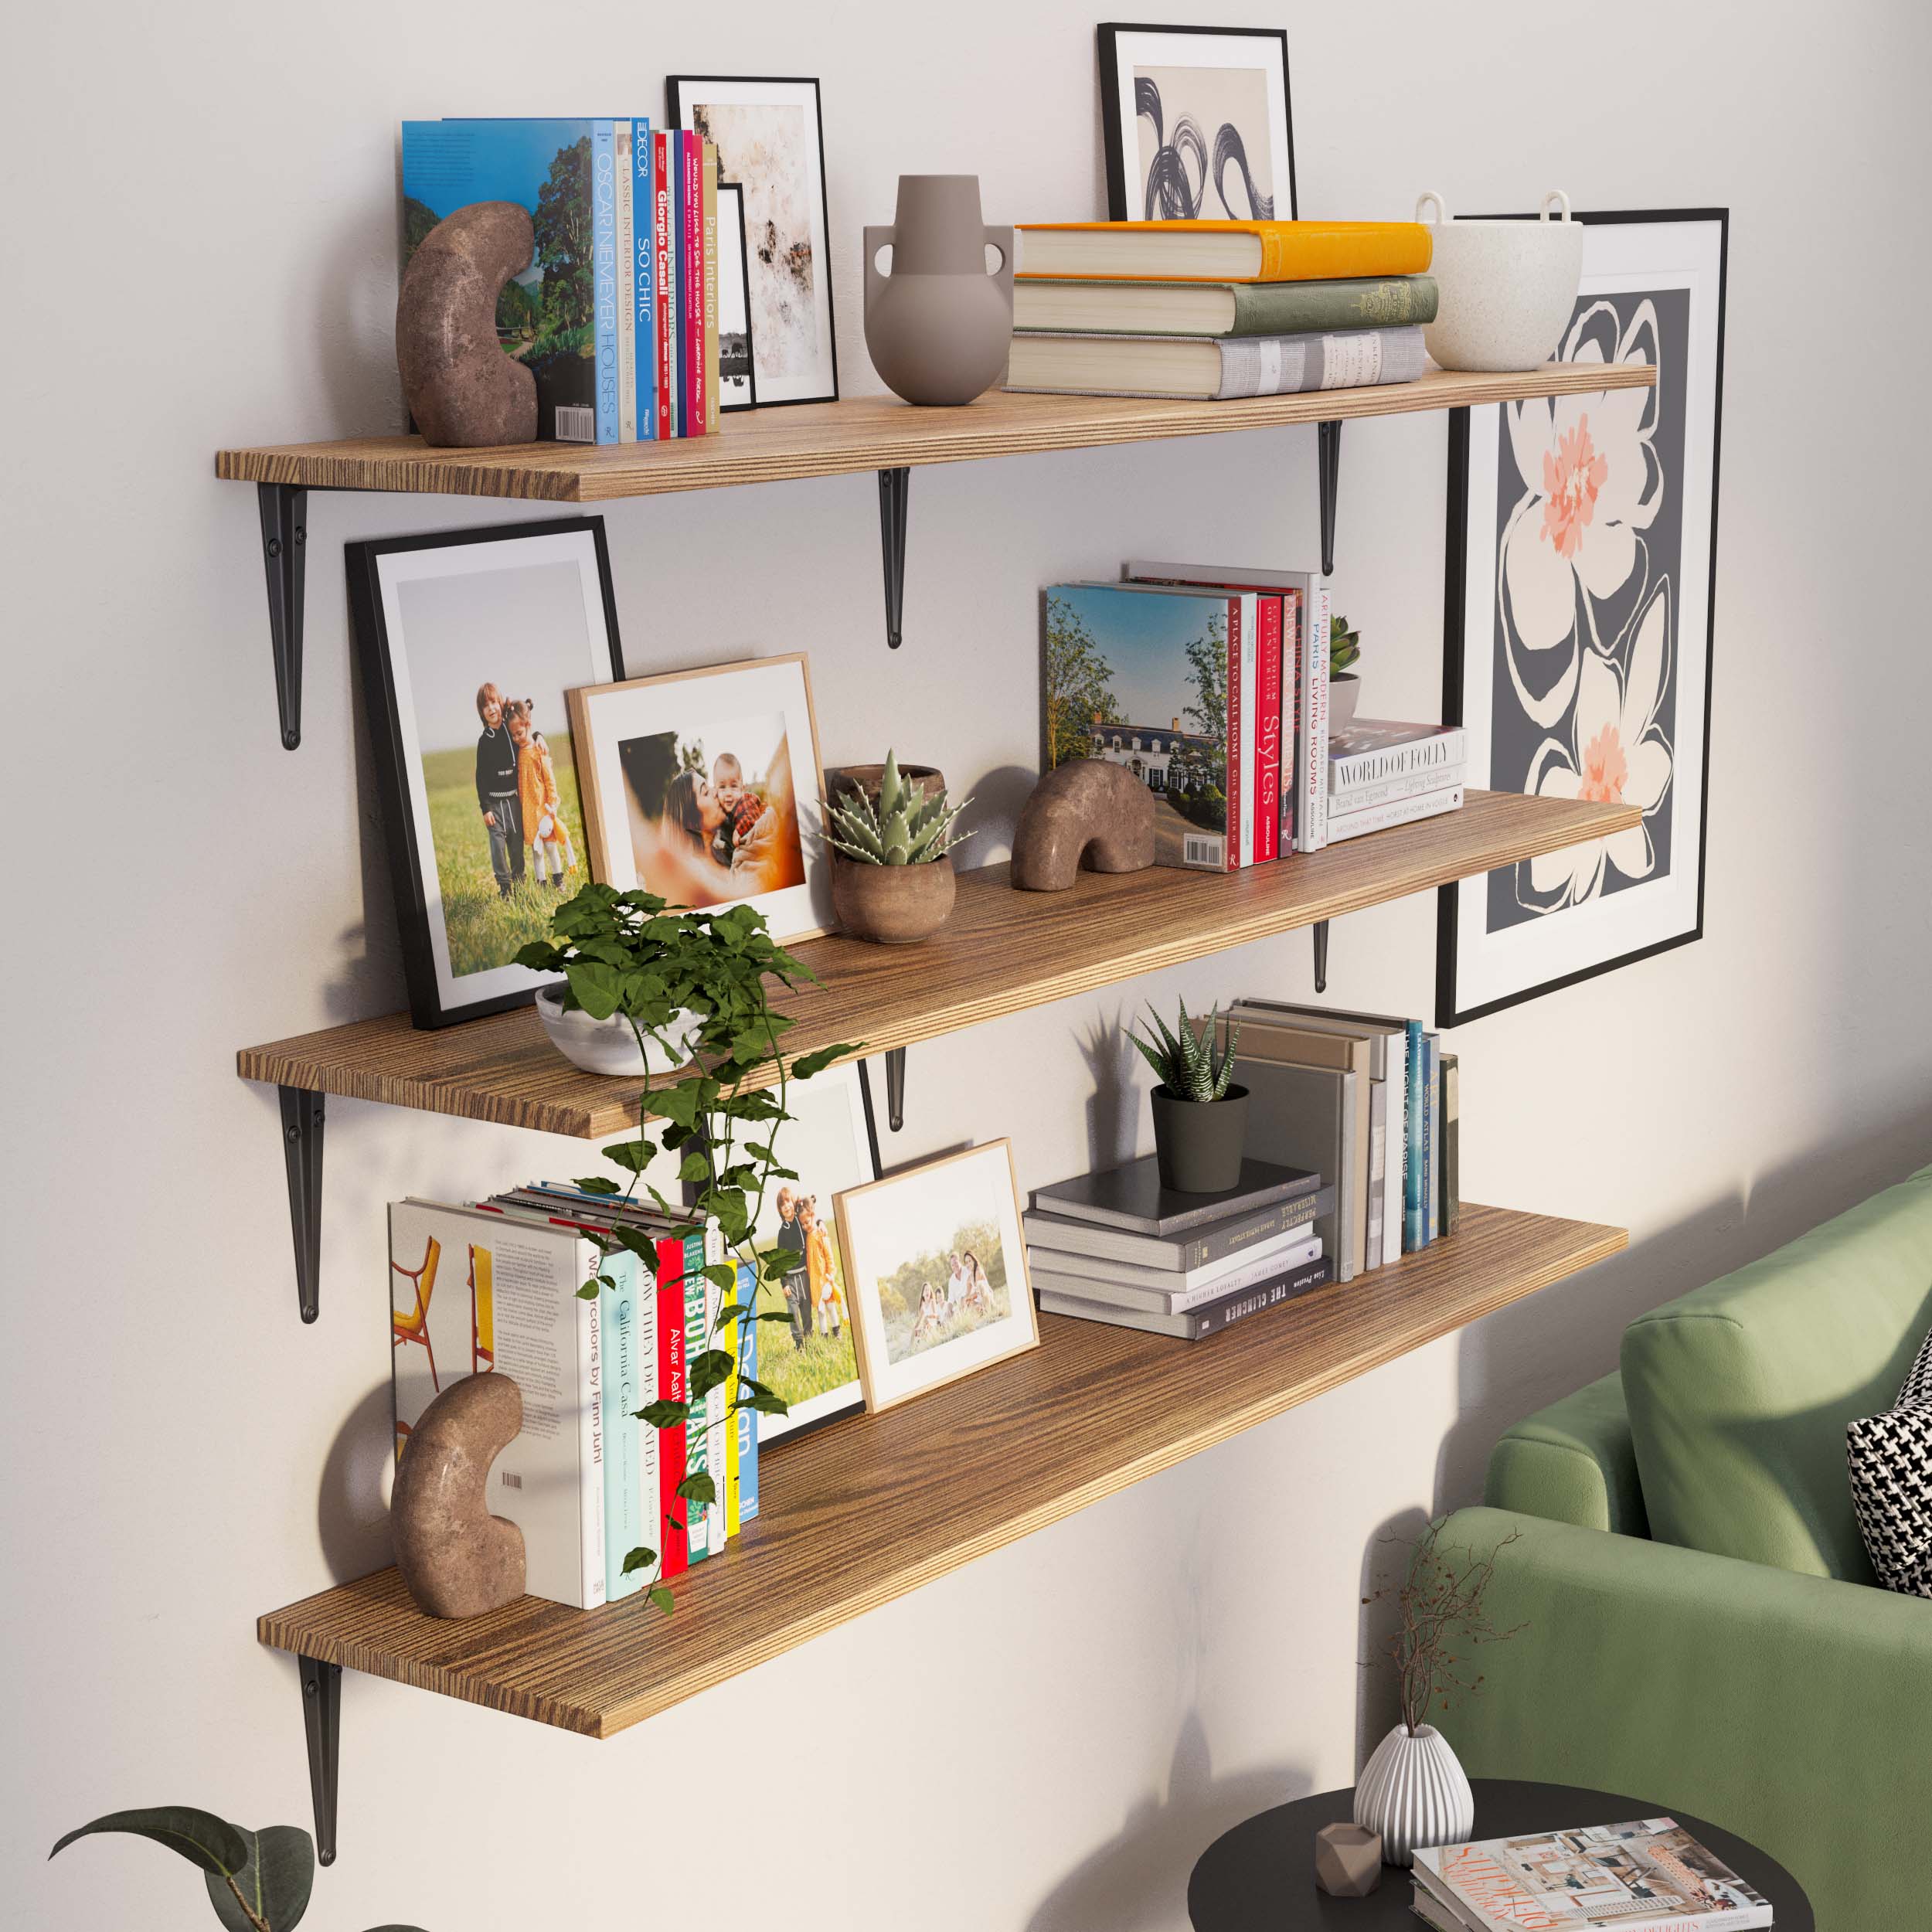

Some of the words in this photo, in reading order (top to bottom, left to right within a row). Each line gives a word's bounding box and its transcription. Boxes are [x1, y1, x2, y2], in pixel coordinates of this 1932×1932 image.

[638, 129, 648, 179] DECOR
[597, 153, 614, 226] OSCAR
[656, 190, 668, 247] Giorgio
[706, 216, 716, 255] Paris
[623, 217, 631, 278] INTERIOR
[638, 237, 651, 268] SO
[695, 235, 700, 248] TO
[599, 231, 615, 329] NIEMEYER
[658, 250, 668, 295] Casali
[639, 272, 651, 322] CHIC
[706, 260, 716, 328] Interiors
[600, 334, 617, 414] HOUSES
[1232, 607, 1239, 616] A
[1267, 606, 1274, 624] OF
[1285, 607, 1296, 641] NEW
[1321, 594, 1329, 655] ARTFULLY
[1284, 645, 1295, 687] YORK
[1294, 624, 1304, 680] CHINA
[1232, 662, 1239, 682] TO
[1284, 690, 1294, 788] APARTMENTS
[1257, 716, 1281, 805] Styles
[1340, 755, 1389, 786] WORLD
[1390, 751, 1409, 774] OF
[1410, 741, 1447, 770] FOLLY
[1335, 797, 1353, 811] Brand
[1354, 795, 1365, 804] van
[1365, 784, 1389, 804] Egmond
[1403, 1107, 1409, 1127] OF
[1281, 1195, 1317, 1218] MISERABLE
[1281, 1207, 1317, 1230] PERFECTLY
[588, 1254, 600, 1362] Warcolors
[1225, 1291, 1267, 1322] CLINCHER
[1270, 1283, 1287, 1303] THE
[619, 1298, 631, 1377] California
[643, 1304, 654, 1356] THEY
[670, 1328, 682, 1366] Alvar
[590, 1366, 600, 1386] by
[671, 1371, 682, 1403] Aalt
[591, 1390, 601, 1427] Finn
[621, 1380, 631, 1417] Casa
[593, 1430, 602, 1464] Juhl
